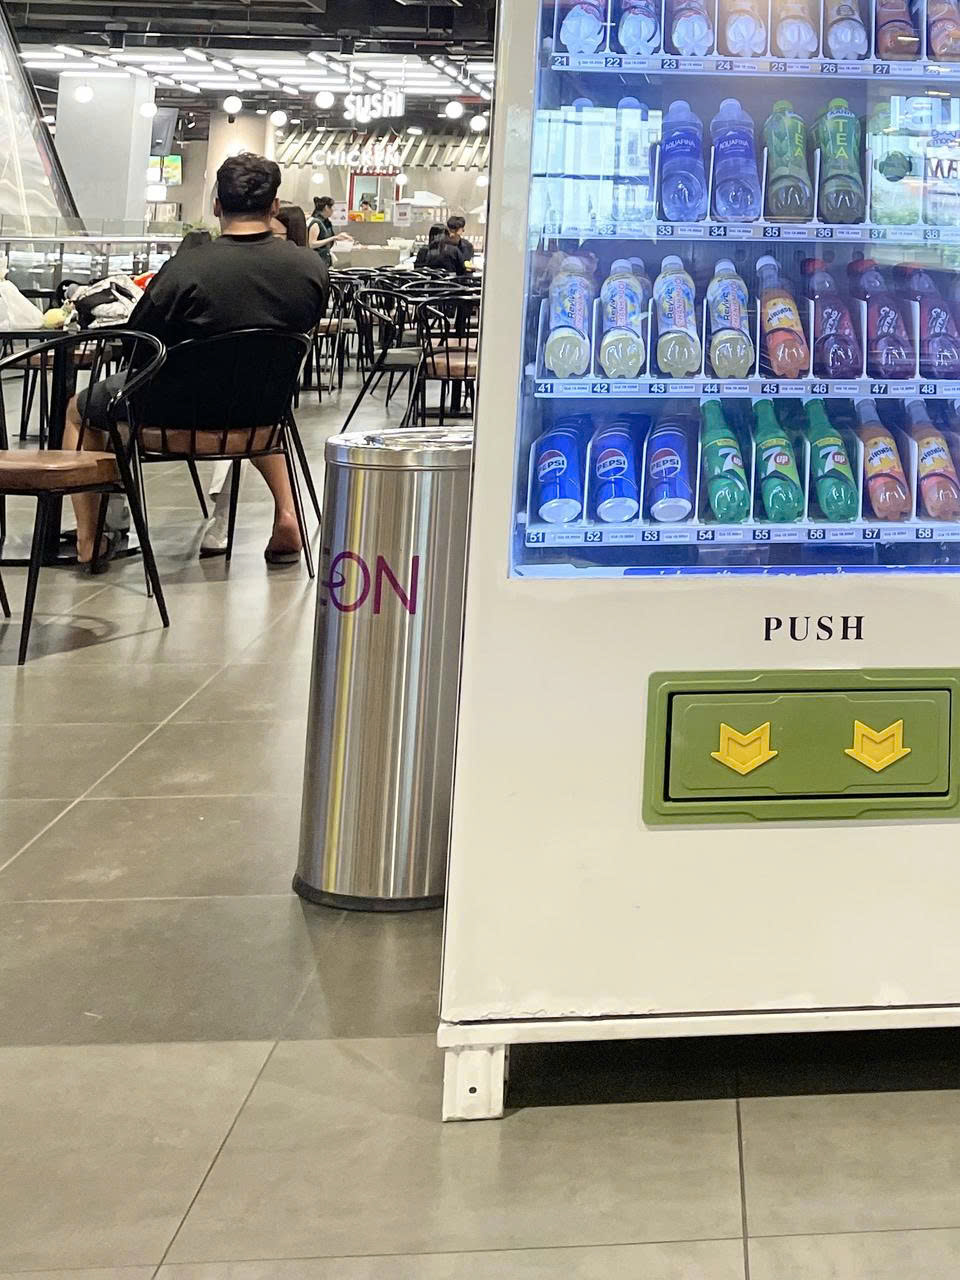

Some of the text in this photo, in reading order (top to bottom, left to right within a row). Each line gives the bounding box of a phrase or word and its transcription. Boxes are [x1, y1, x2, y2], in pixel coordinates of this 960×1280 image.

[554, 56, 568, 66] 21
[606, 58, 621, 67] 22
[663, 60, 677, 69] 23
[717, 61, 731, 70] 24
[771, 62, 785, 71] 25
[822, 64, 836, 73] 26
[875, 64, 889, 74] 27
[718, 138, 750, 151] AQUAFINA
[834, 119, 848, 160] TEA
[665, 138, 696, 152] AQUAFINA
[600, 225, 614, 234] 32
[659, 226, 672, 235] 33
[711, 226, 725, 235] 34
[765, 227, 779, 237] 35
[818, 228, 831, 238] 36
[871, 229, 884, 238] 37
[925, 230, 939, 239] 38
[666, 287, 675, 319] Revive
[722, 291, 730, 320] Revive
[538, 384, 551, 393] 41
[594, 383, 609, 393] 42
[650, 383, 665, 393] 43
[704, 383, 718, 393] 44
[762, 384, 777, 394] 45
[812, 384, 827, 394] 46
[872, 384, 886, 394] 47
[921, 384, 935, 394] 48
[540, 460, 565, 472] EPSI
[597, 460, 626, 471] PEPSI
[651, 459, 679, 471] PEPSI
[529, 532, 544, 543] 51
[586, 532, 601, 542] 52
[643, 531, 659, 541] 53
[699, 531, 714, 541] 54
[754, 530, 770, 540] 55
[809, 529, 824, 539] 56
[865, 529, 880, 539] 57
[917, 528, 932, 538] 58
[764, 615, 864, 641] PUSH
